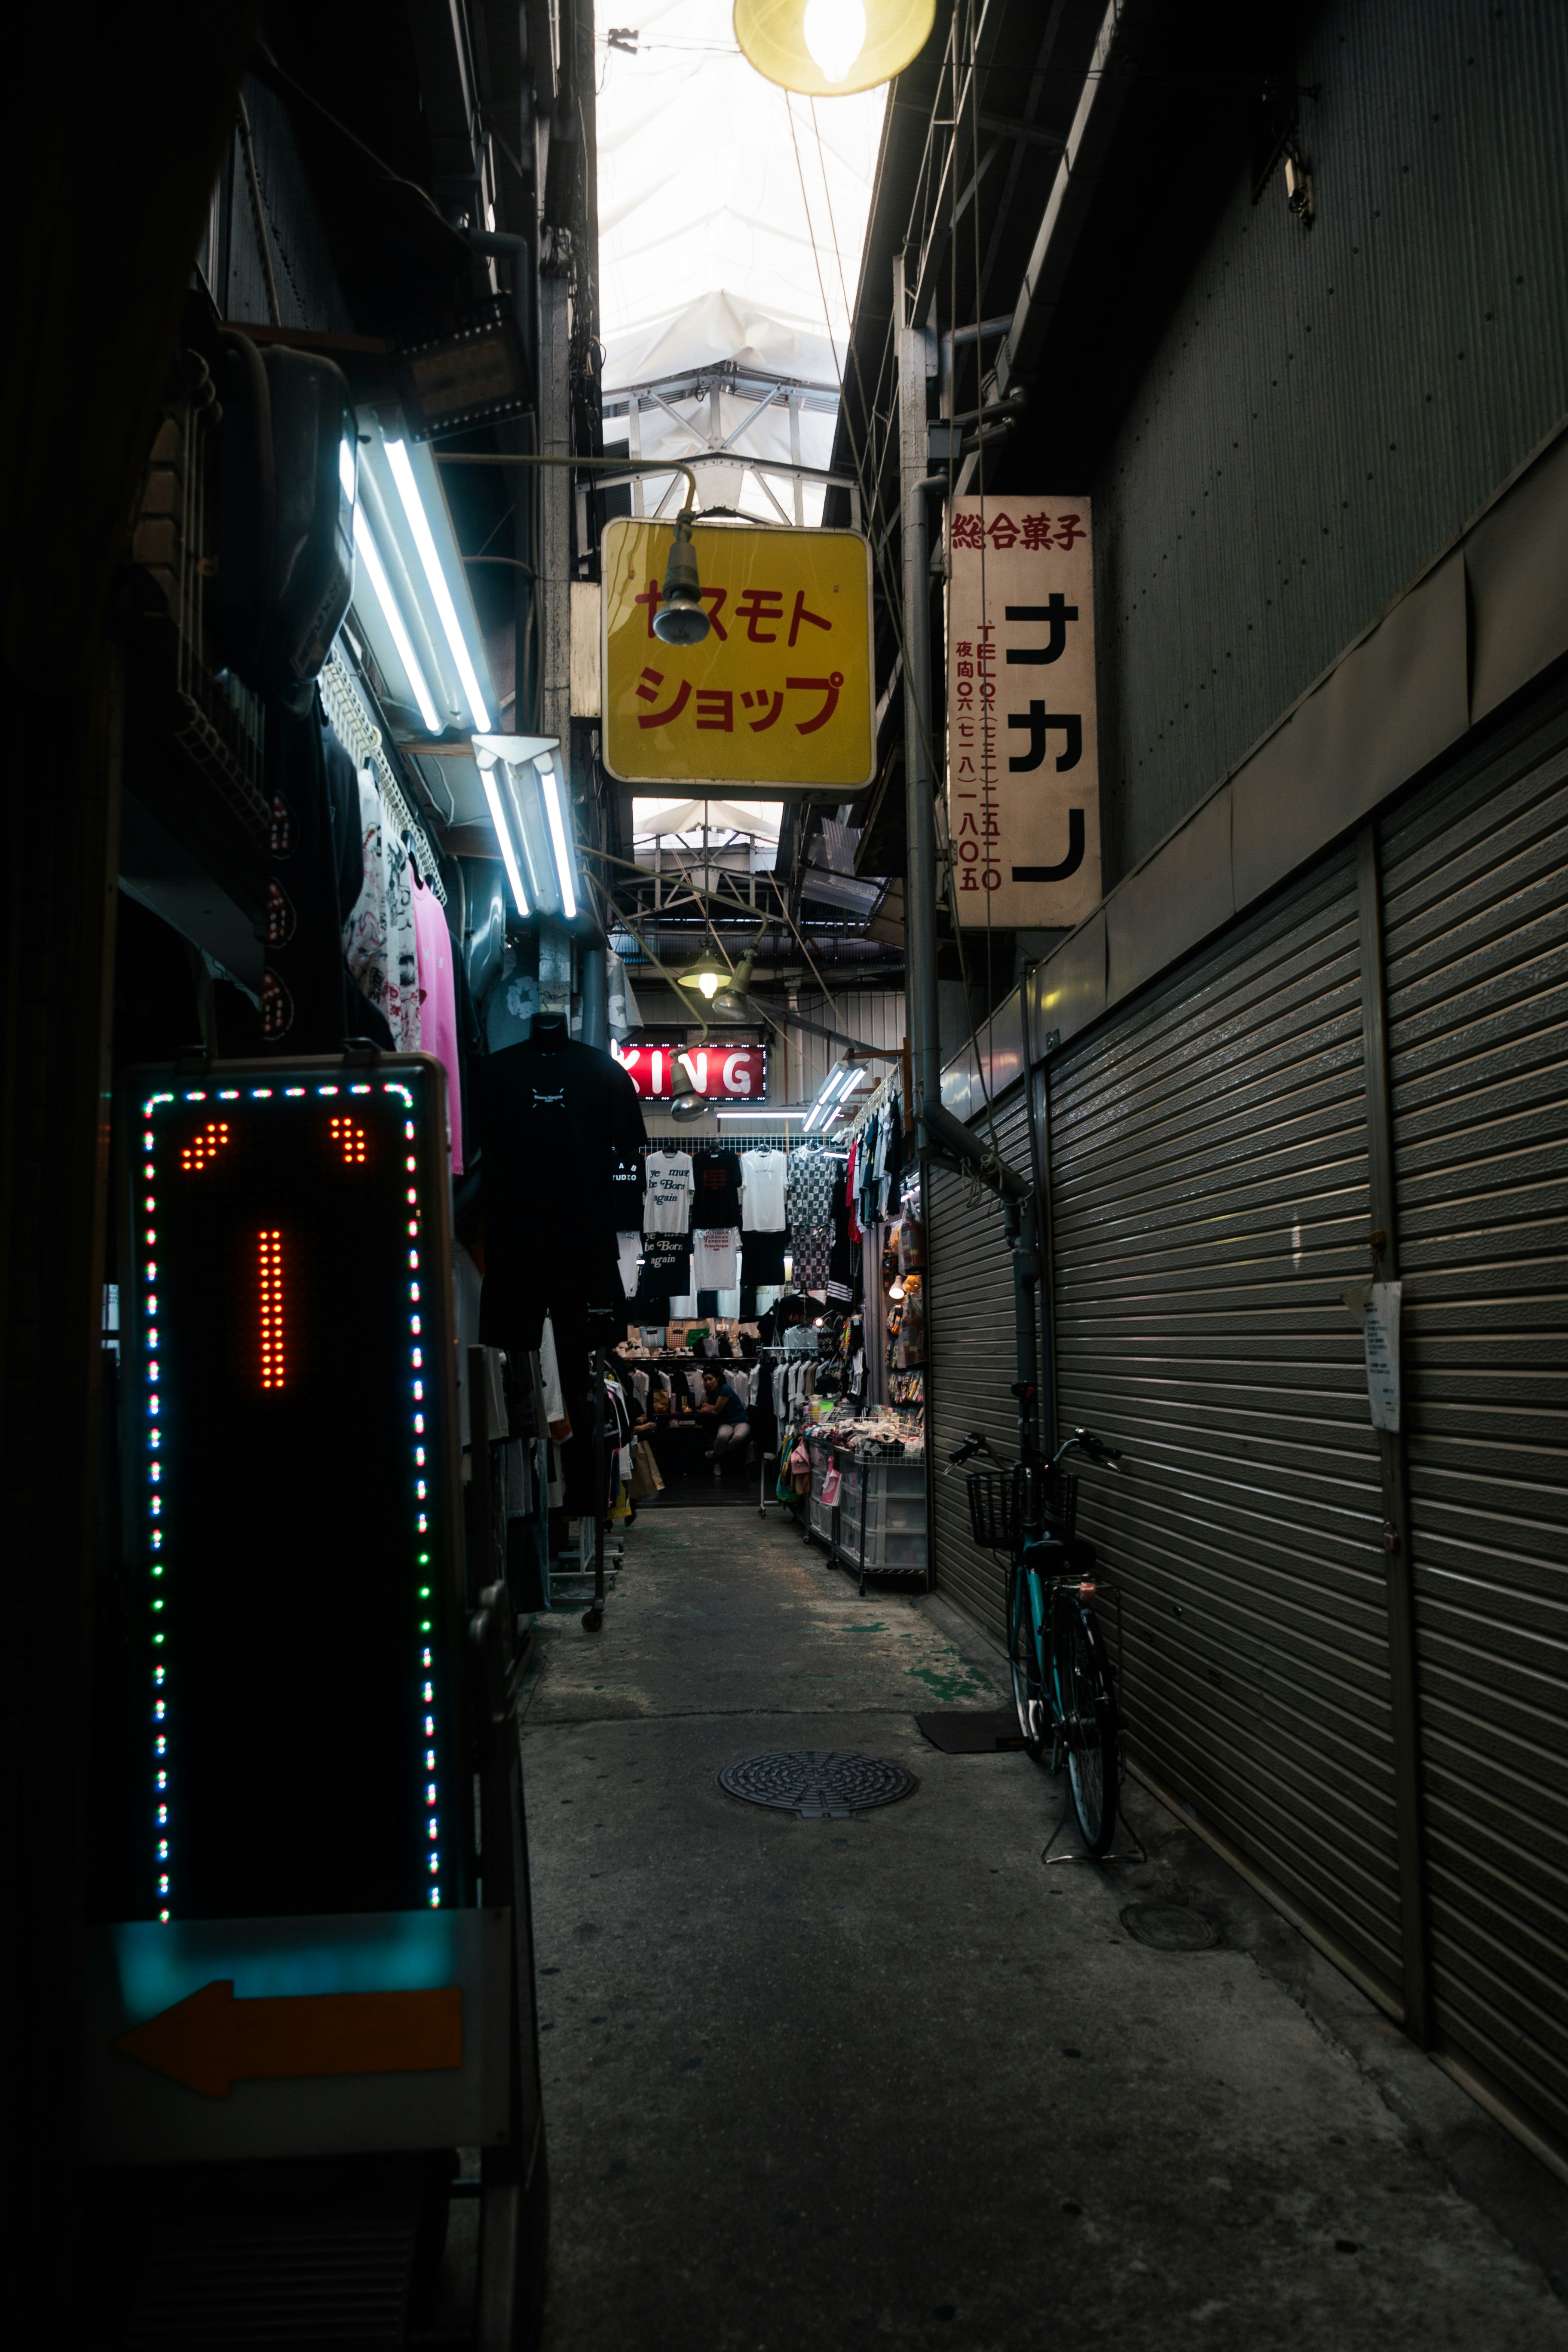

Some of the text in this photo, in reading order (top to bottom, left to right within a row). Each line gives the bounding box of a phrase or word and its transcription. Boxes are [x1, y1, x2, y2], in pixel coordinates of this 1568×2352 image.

[950, 512, 1087, 551] 総合菓子
[635, 666, 844, 736] ショップ
[1005, 593, 1085, 882] ナカノ
[649, 1169, 690, 1178] ye must
[648, 1179, 686, 1190] be Born
[653, 1193, 677, 1205] again
[644, 1240, 683, 1252] be Born
[650, 1255, 676, 1268] again
